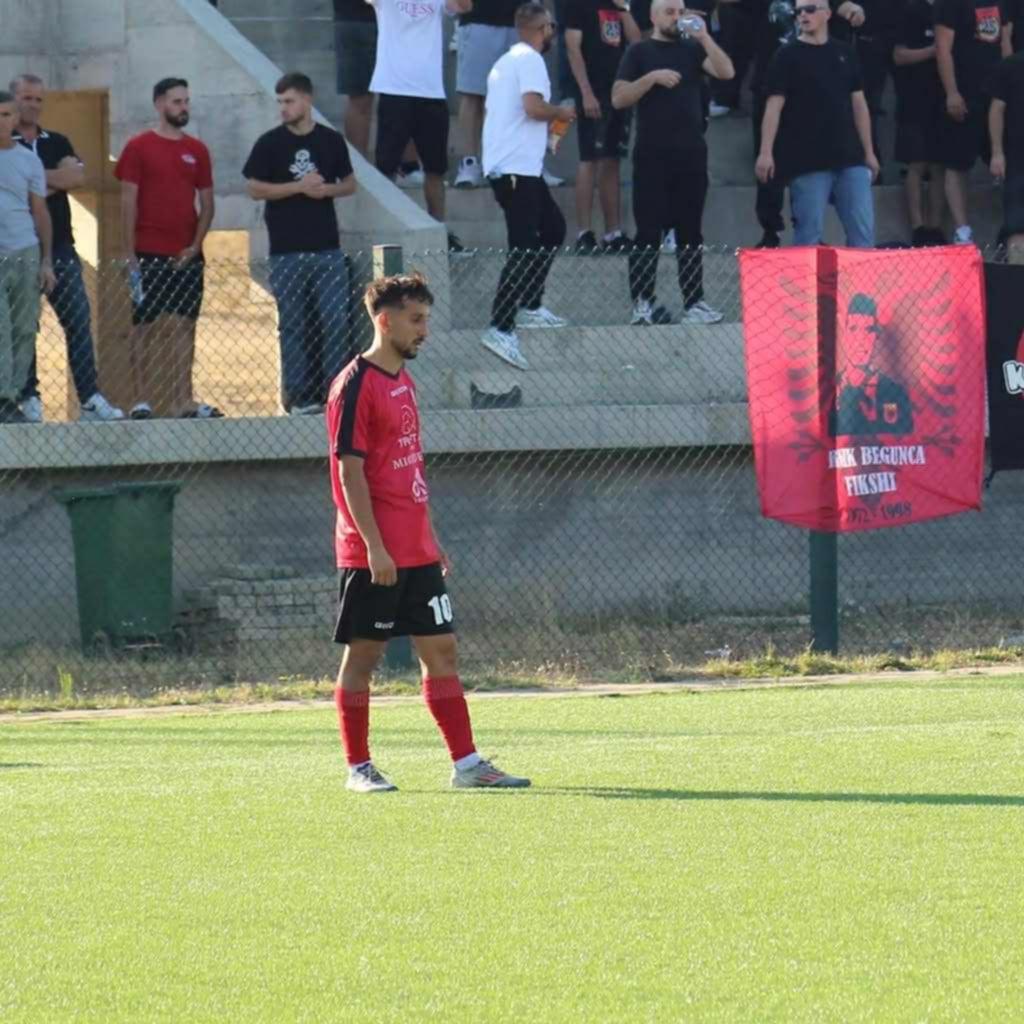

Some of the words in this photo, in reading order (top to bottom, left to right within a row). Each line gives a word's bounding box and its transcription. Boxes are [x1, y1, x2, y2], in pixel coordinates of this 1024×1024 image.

[860, 445, 926, 466] BEGUNCA
[844, 472, 897, 496] FIKSHI
[427, 593, 453, 626] 10
